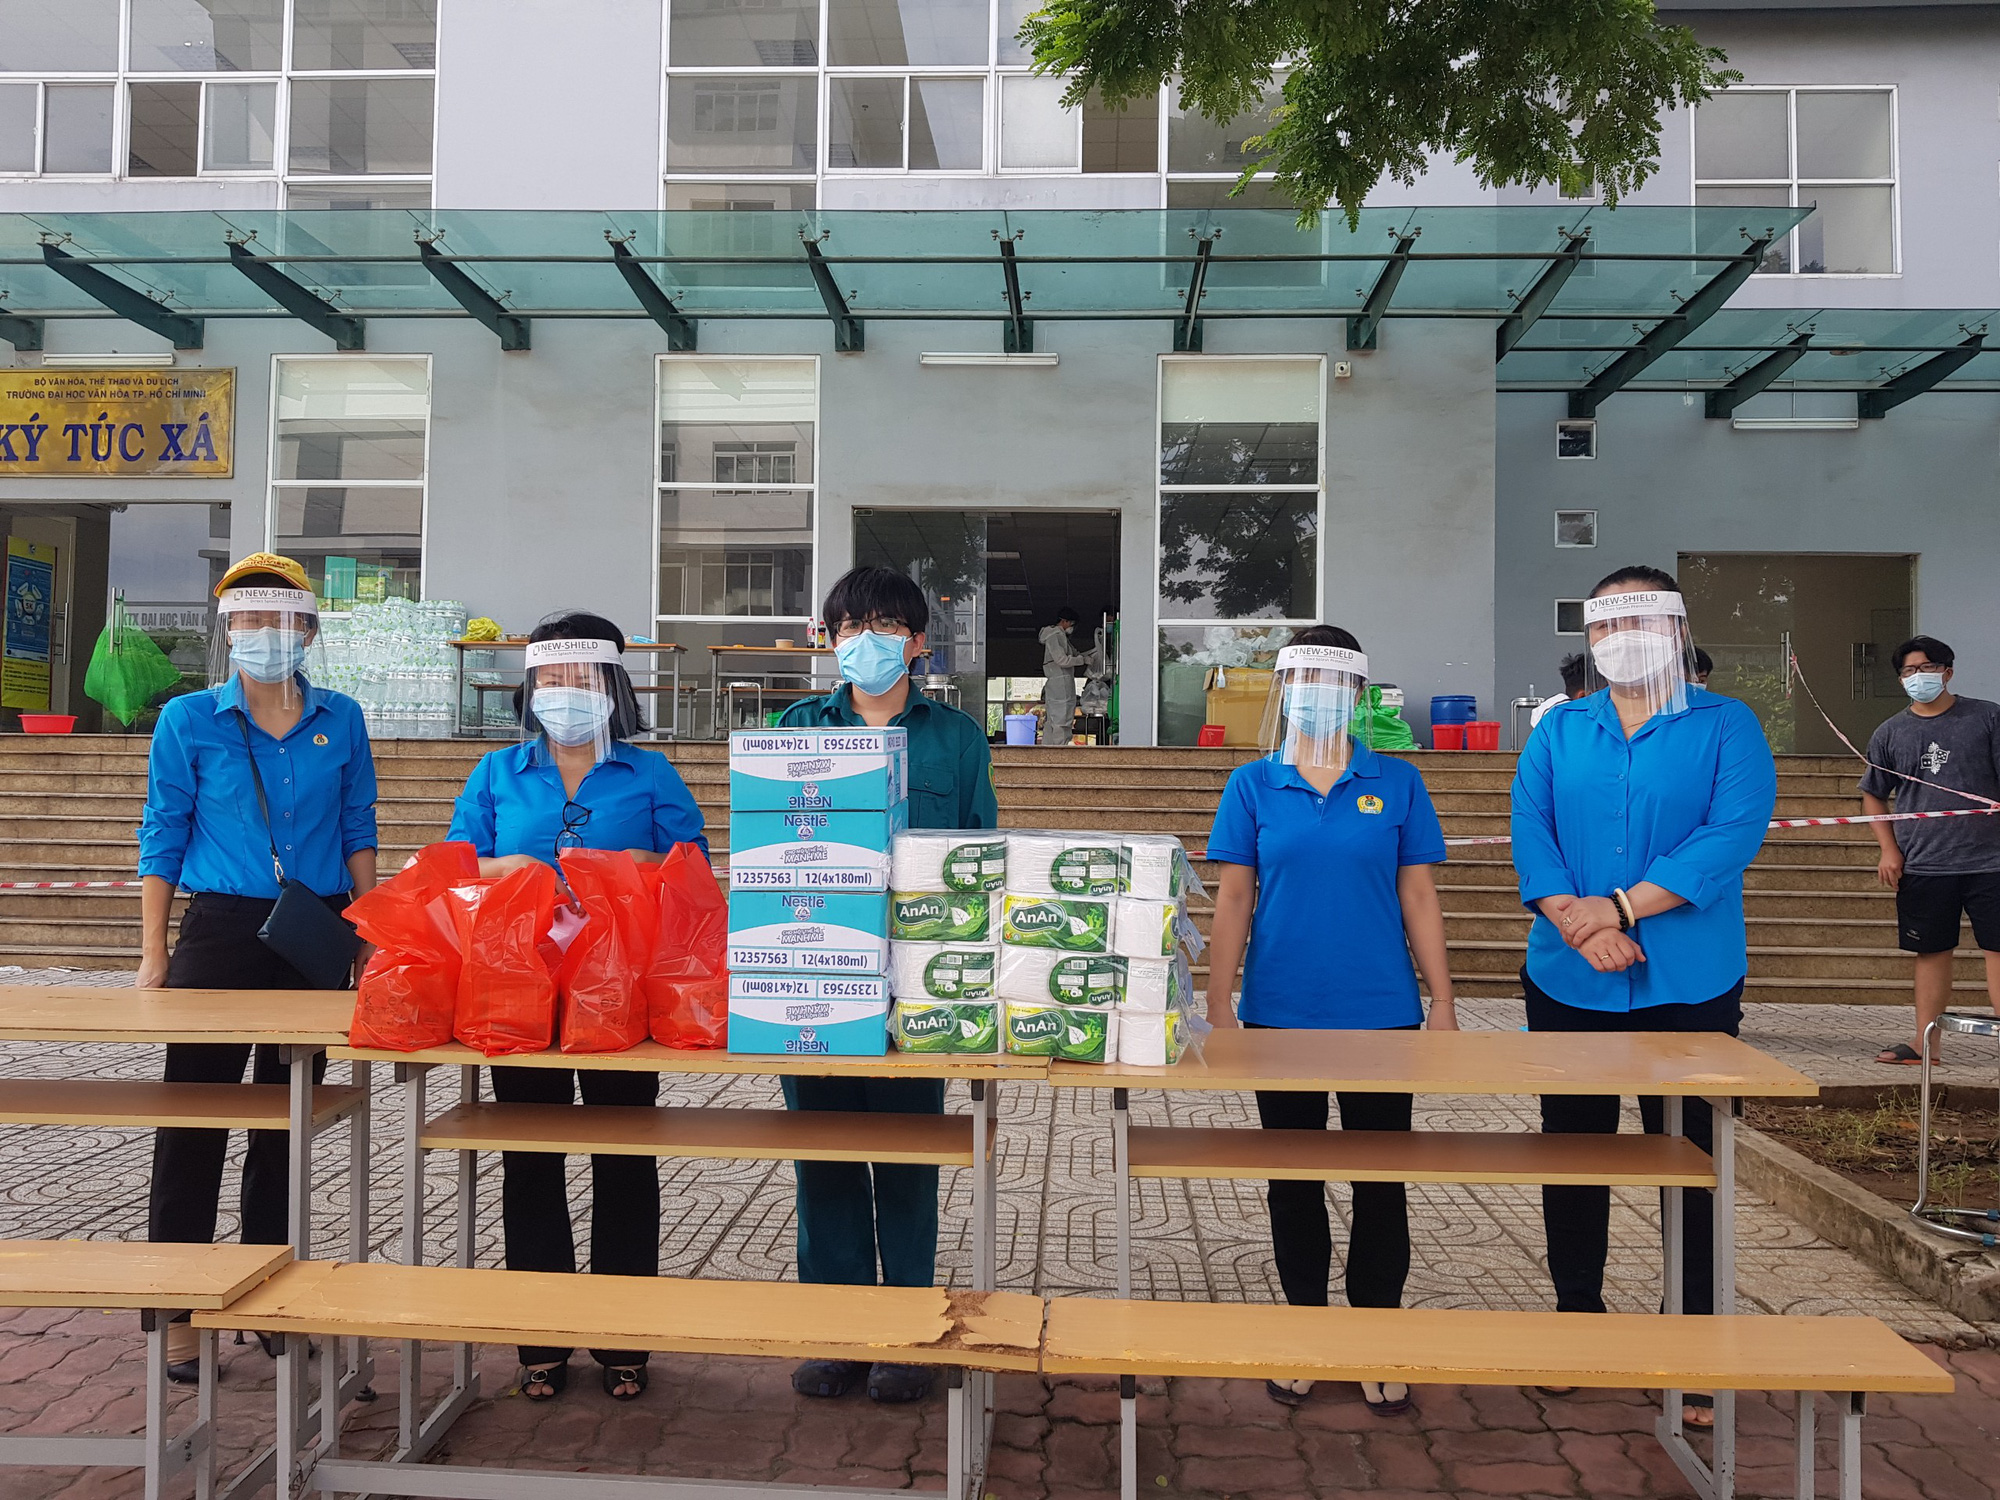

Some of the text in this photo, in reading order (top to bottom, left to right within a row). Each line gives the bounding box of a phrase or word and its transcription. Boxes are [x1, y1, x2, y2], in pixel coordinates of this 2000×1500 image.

[34, 377, 47, 387] BỘ
[49, 378, 65, 386] VĂN
[133, 377, 144, 386] VÀ
[160, 379, 179, 387] LỊCH
[6, 389, 45, 399] TRƯỜNG
[48, 390, 63, 400] ĐẠI
[66, 390, 86, 400] HỌC
[88, 388, 107, 399] VĂN
[133, 390, 147, 399] TP.
[166, 388, 181, 399] CHÍ
[62, 412, 145, 462] TÚC
[158, 412, 218, 462] XÁ
[245, 589, 304, 600] NEW-SHIELD
[1598, 593, 1658, 607] NEW-SHIELD
[180, 610, 199, 626] VĂN
[541, 641, 598, 651] NEW-SHIELD
[1299, 647, 1354, 660] NEW-SHIELD
[742, 737, 810, 751] 12(4x180ml)
[824, 738, 879, 750] 12357563
[736, 872, 791, 884] 12357563
[805, 872, 872, 886] 12(4x180ml)
[1093, 883, 1113, 892] AnAn
[900, 903, 939, 918] AnAn
[1016, 910, 1057, 924] AnAn
[733, 951, 788, 964] 12357563
[801, 953, 868, 968] 12(4x180ml)
[742, 979, 809, 994] 12(4x180ml)
[823, 982, 878, 995] 12357563
[1091, 993, 1112, 1002] AnAn
[906, 1016, 948, 1031] AnAn
[1015, 1019, 1057, 1034] AnAn
